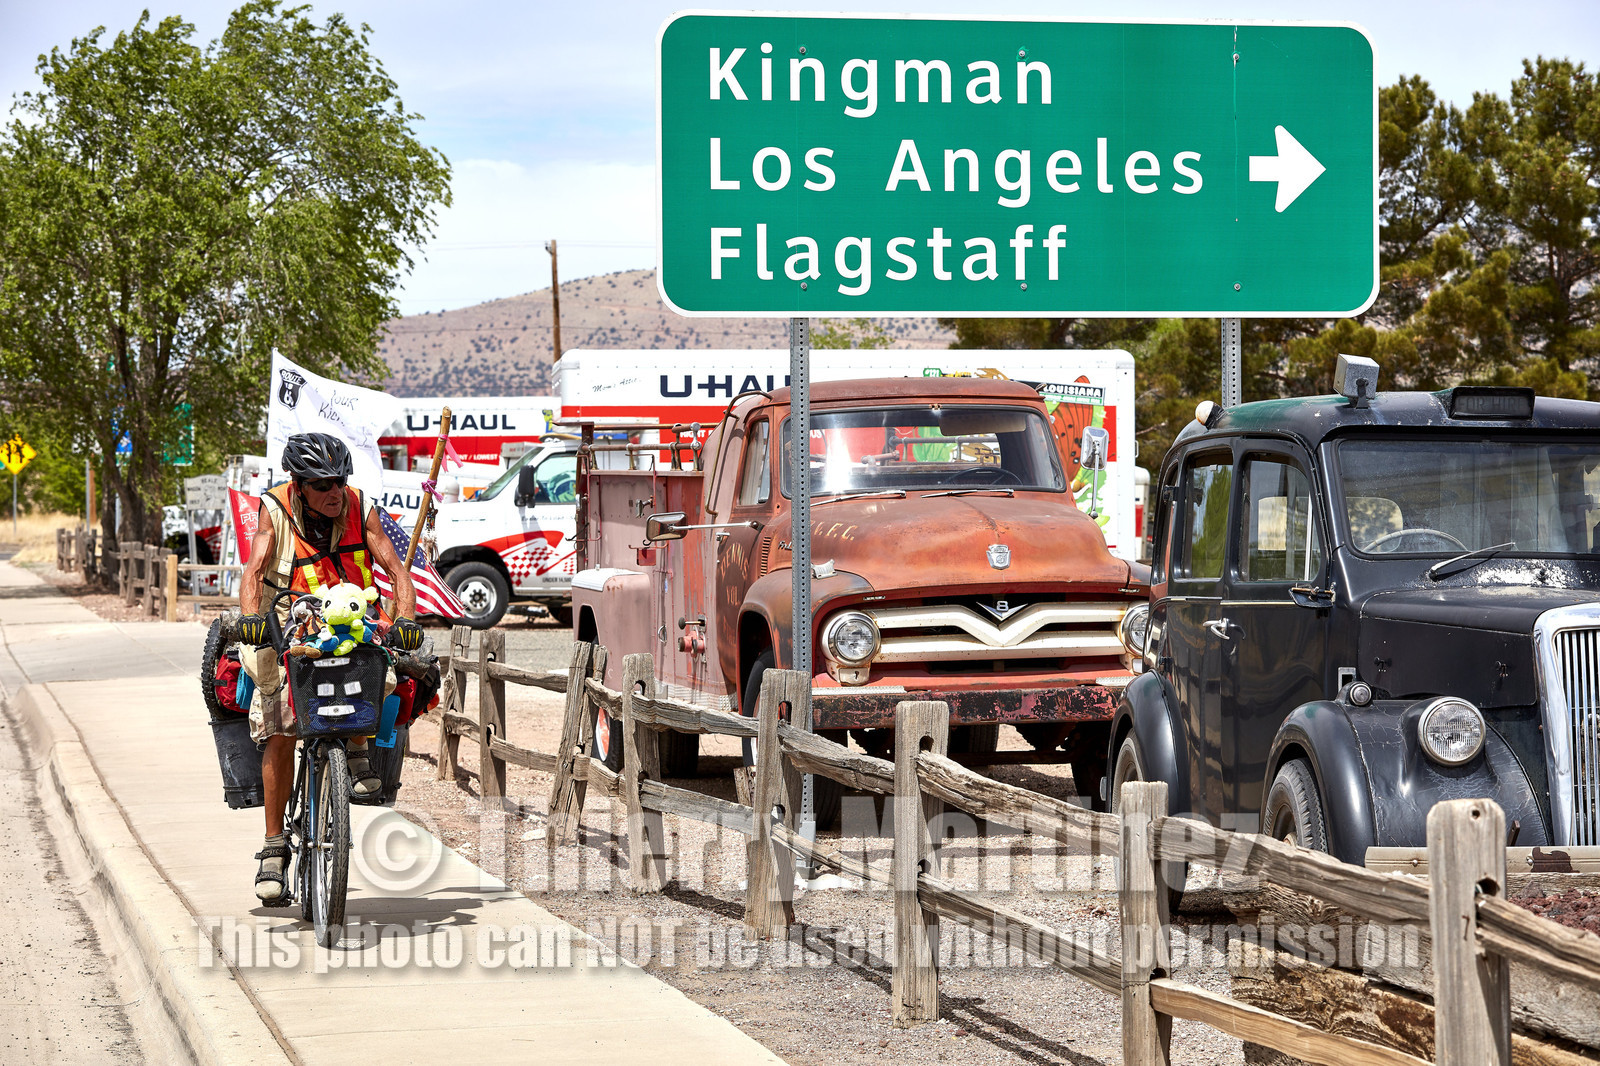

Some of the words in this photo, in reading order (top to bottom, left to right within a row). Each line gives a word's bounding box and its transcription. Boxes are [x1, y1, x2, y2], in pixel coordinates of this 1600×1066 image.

[709, 42, 1052, 118] Kingman
[709, 137, 836, 193] Los
[885, 137, 1204, 208] Angeles
[709, 223, 1067, 297] Flagstaff
[280, 370, 303, 385] ROUTE
[660, 375, 790, 397] U-HAU
[1043, 384, 1102, 398] LOUISIANA
[1457, 396, 1485, 411] FOR
[1493, 396, 1525, 411] HIRE
[240, 511, 259, 526] PR
[720, 543, 749, 582] DENNIS
